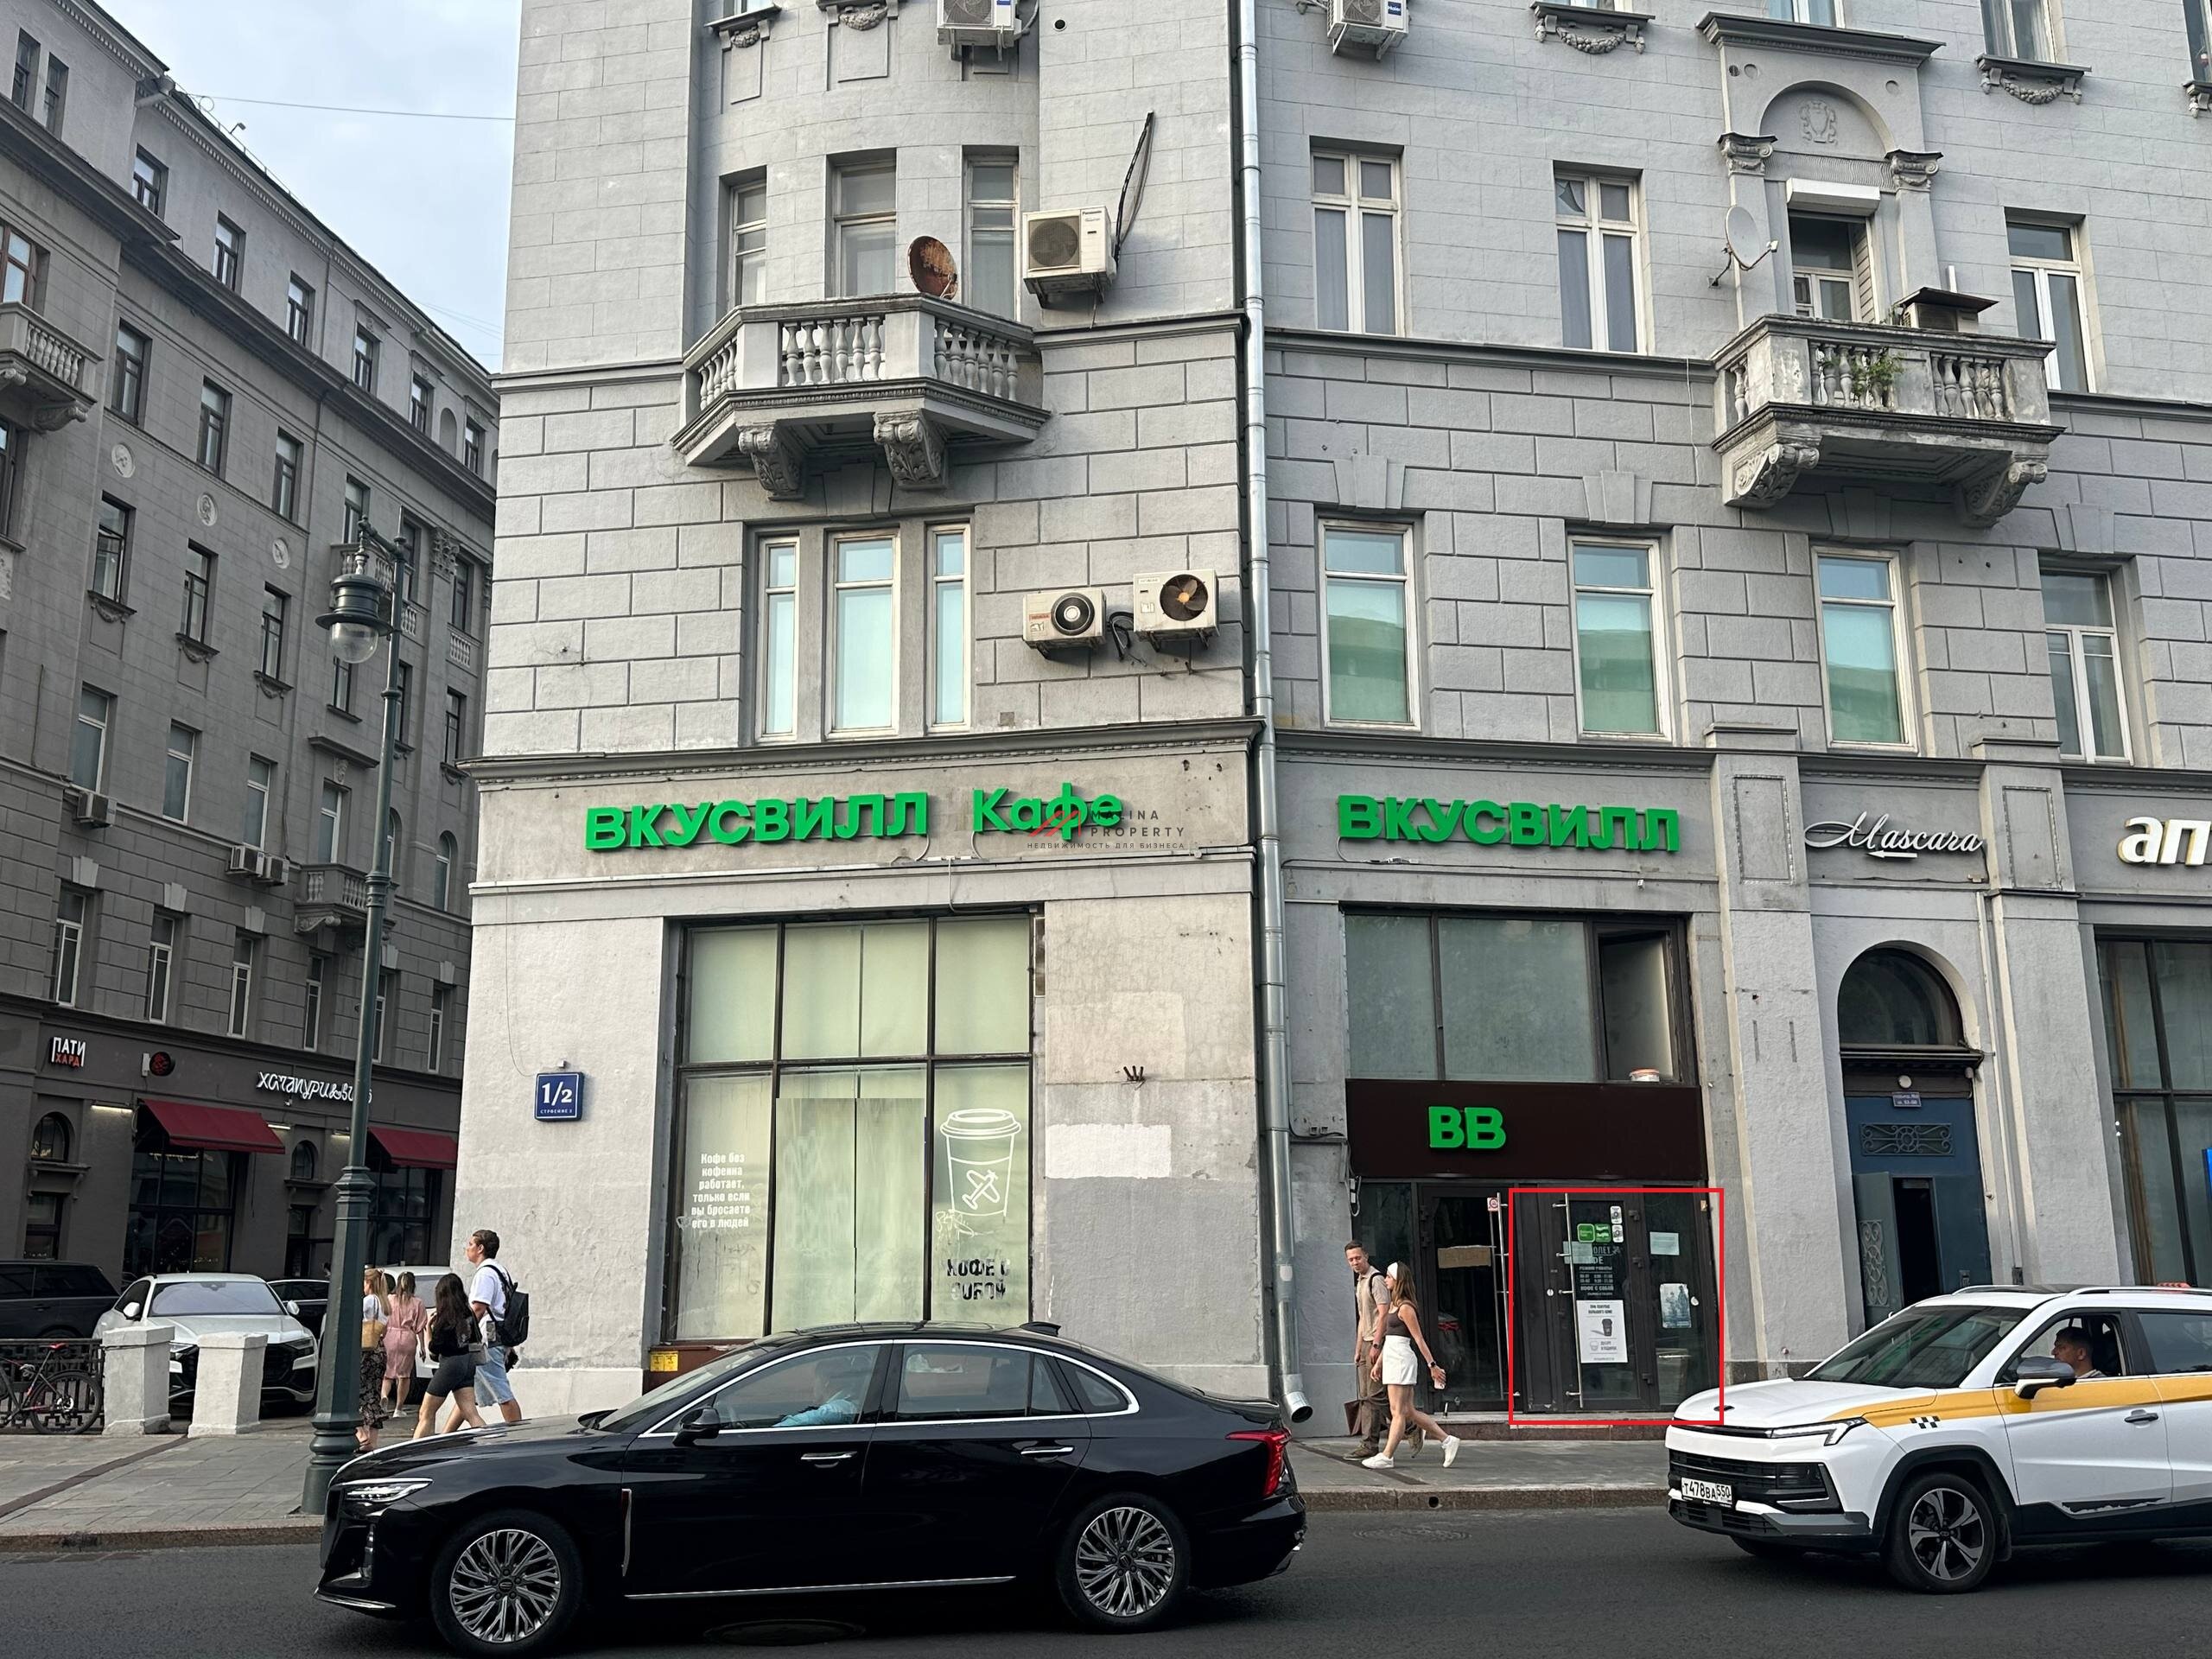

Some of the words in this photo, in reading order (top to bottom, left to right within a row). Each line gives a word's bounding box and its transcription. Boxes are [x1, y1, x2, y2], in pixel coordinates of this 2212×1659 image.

[586, 791, 928, 850] ВКУСВИЛЛ
[972, 782, 1123, 841] Кафе
[1338, 794, 1680, 852] ВКУСВИЛЛ
[1804, 810, 1984, 852] Mascara
[52, 1037, 86, 1067] ПАТИ
[55, 1052, 80, 1068] ХАРД
[542, 1081, 573, 1106] 1/2
[1428, 1106, 1506, 1148] ВВ
[701, 1153, 727, 1165] Кофе
[728, 1152, 745, 1163] без
[691, 1206, 705, 1216] вы
[707, 1204, 751, 1216] бросаете
[692, 1193, 726, 1203] только
[728, 1192, 750, 1202] если
[691, 1219, 708, 1229] его
[717, 1217, 749, 1229] людей
